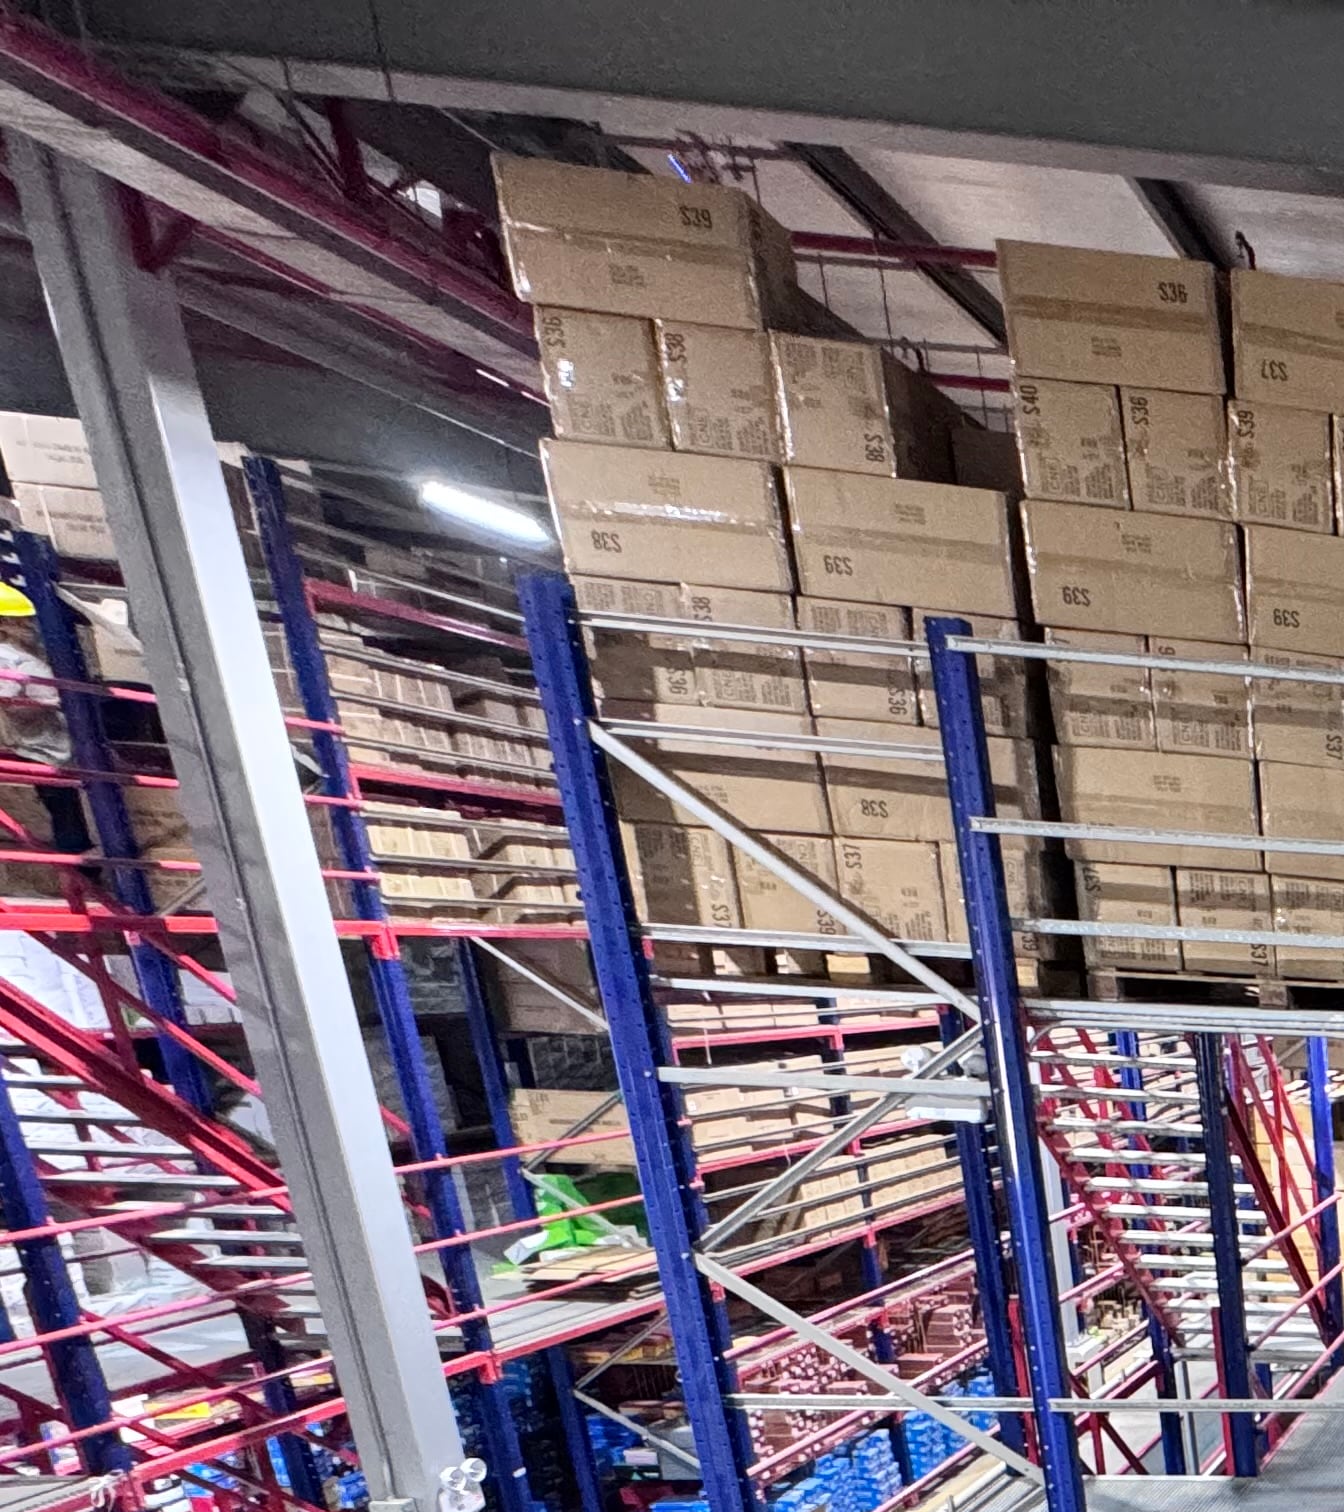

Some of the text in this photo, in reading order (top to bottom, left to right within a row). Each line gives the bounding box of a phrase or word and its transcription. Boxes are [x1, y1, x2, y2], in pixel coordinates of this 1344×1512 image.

[679, 205, 712, 229] S39
[1157, 281, 1188, 304] S36
[665, 333, 686, 362] S38
[1261, 358, 1288, 382] S37
[1020, 385, 1041, 416] S40
[1130, 396, 1149, 426] S36
[864, 433, 885, 462] S38
[591, 530, 622, 553] S38
[823, 555, 853, 576] S39
[1325, 734, 1343, 760] S37
[861, 799, 888, 818] S38
[843, 843, 862, 869] S37
[1250, 943, 1268, 967] S37
